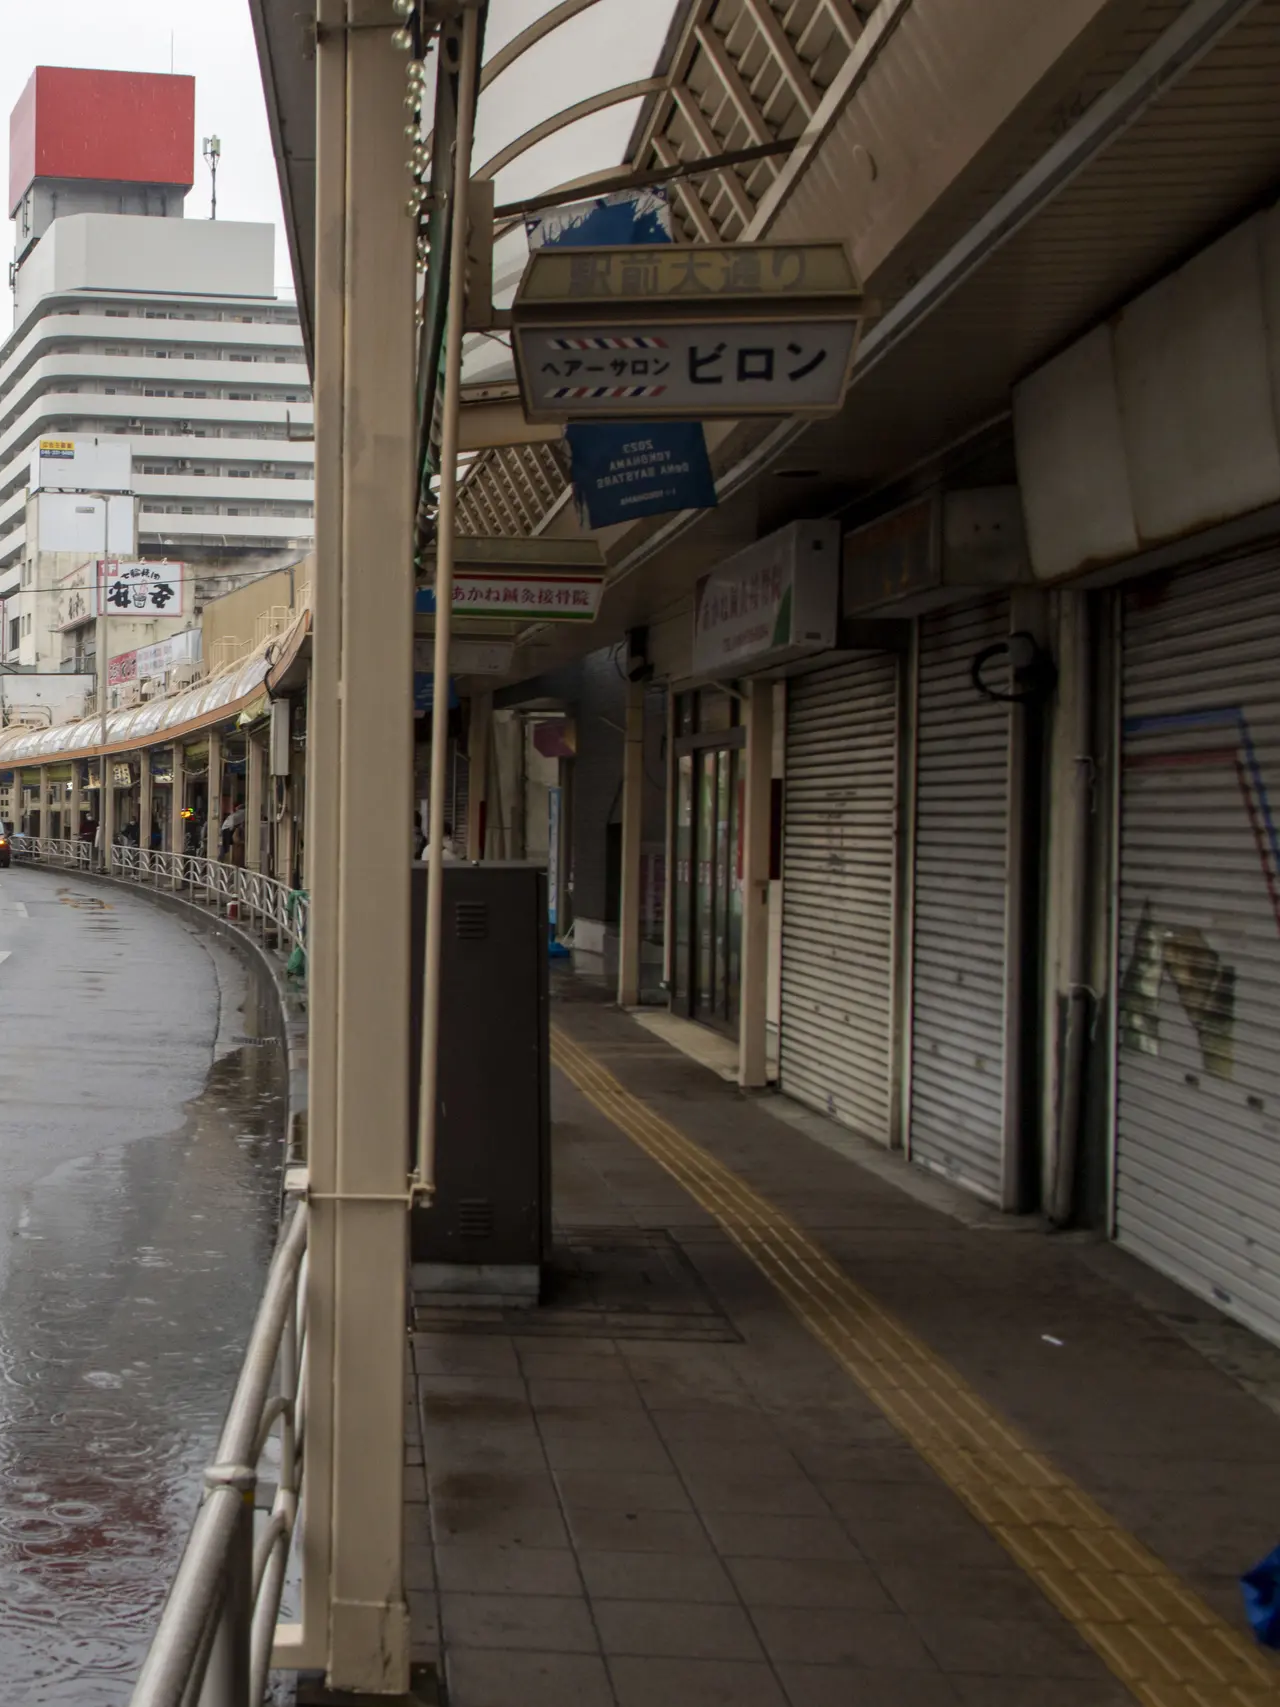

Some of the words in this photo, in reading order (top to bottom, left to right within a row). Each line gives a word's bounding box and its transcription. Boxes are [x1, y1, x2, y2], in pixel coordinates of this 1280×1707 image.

[569, 251, 808, 297] 駅前大通り
[541, 356, 671, 378] ヘアーサロン
[687, 343, 827, 386] ビロン
[452, 584, 590, 606] あかね鍼灸接骨院
